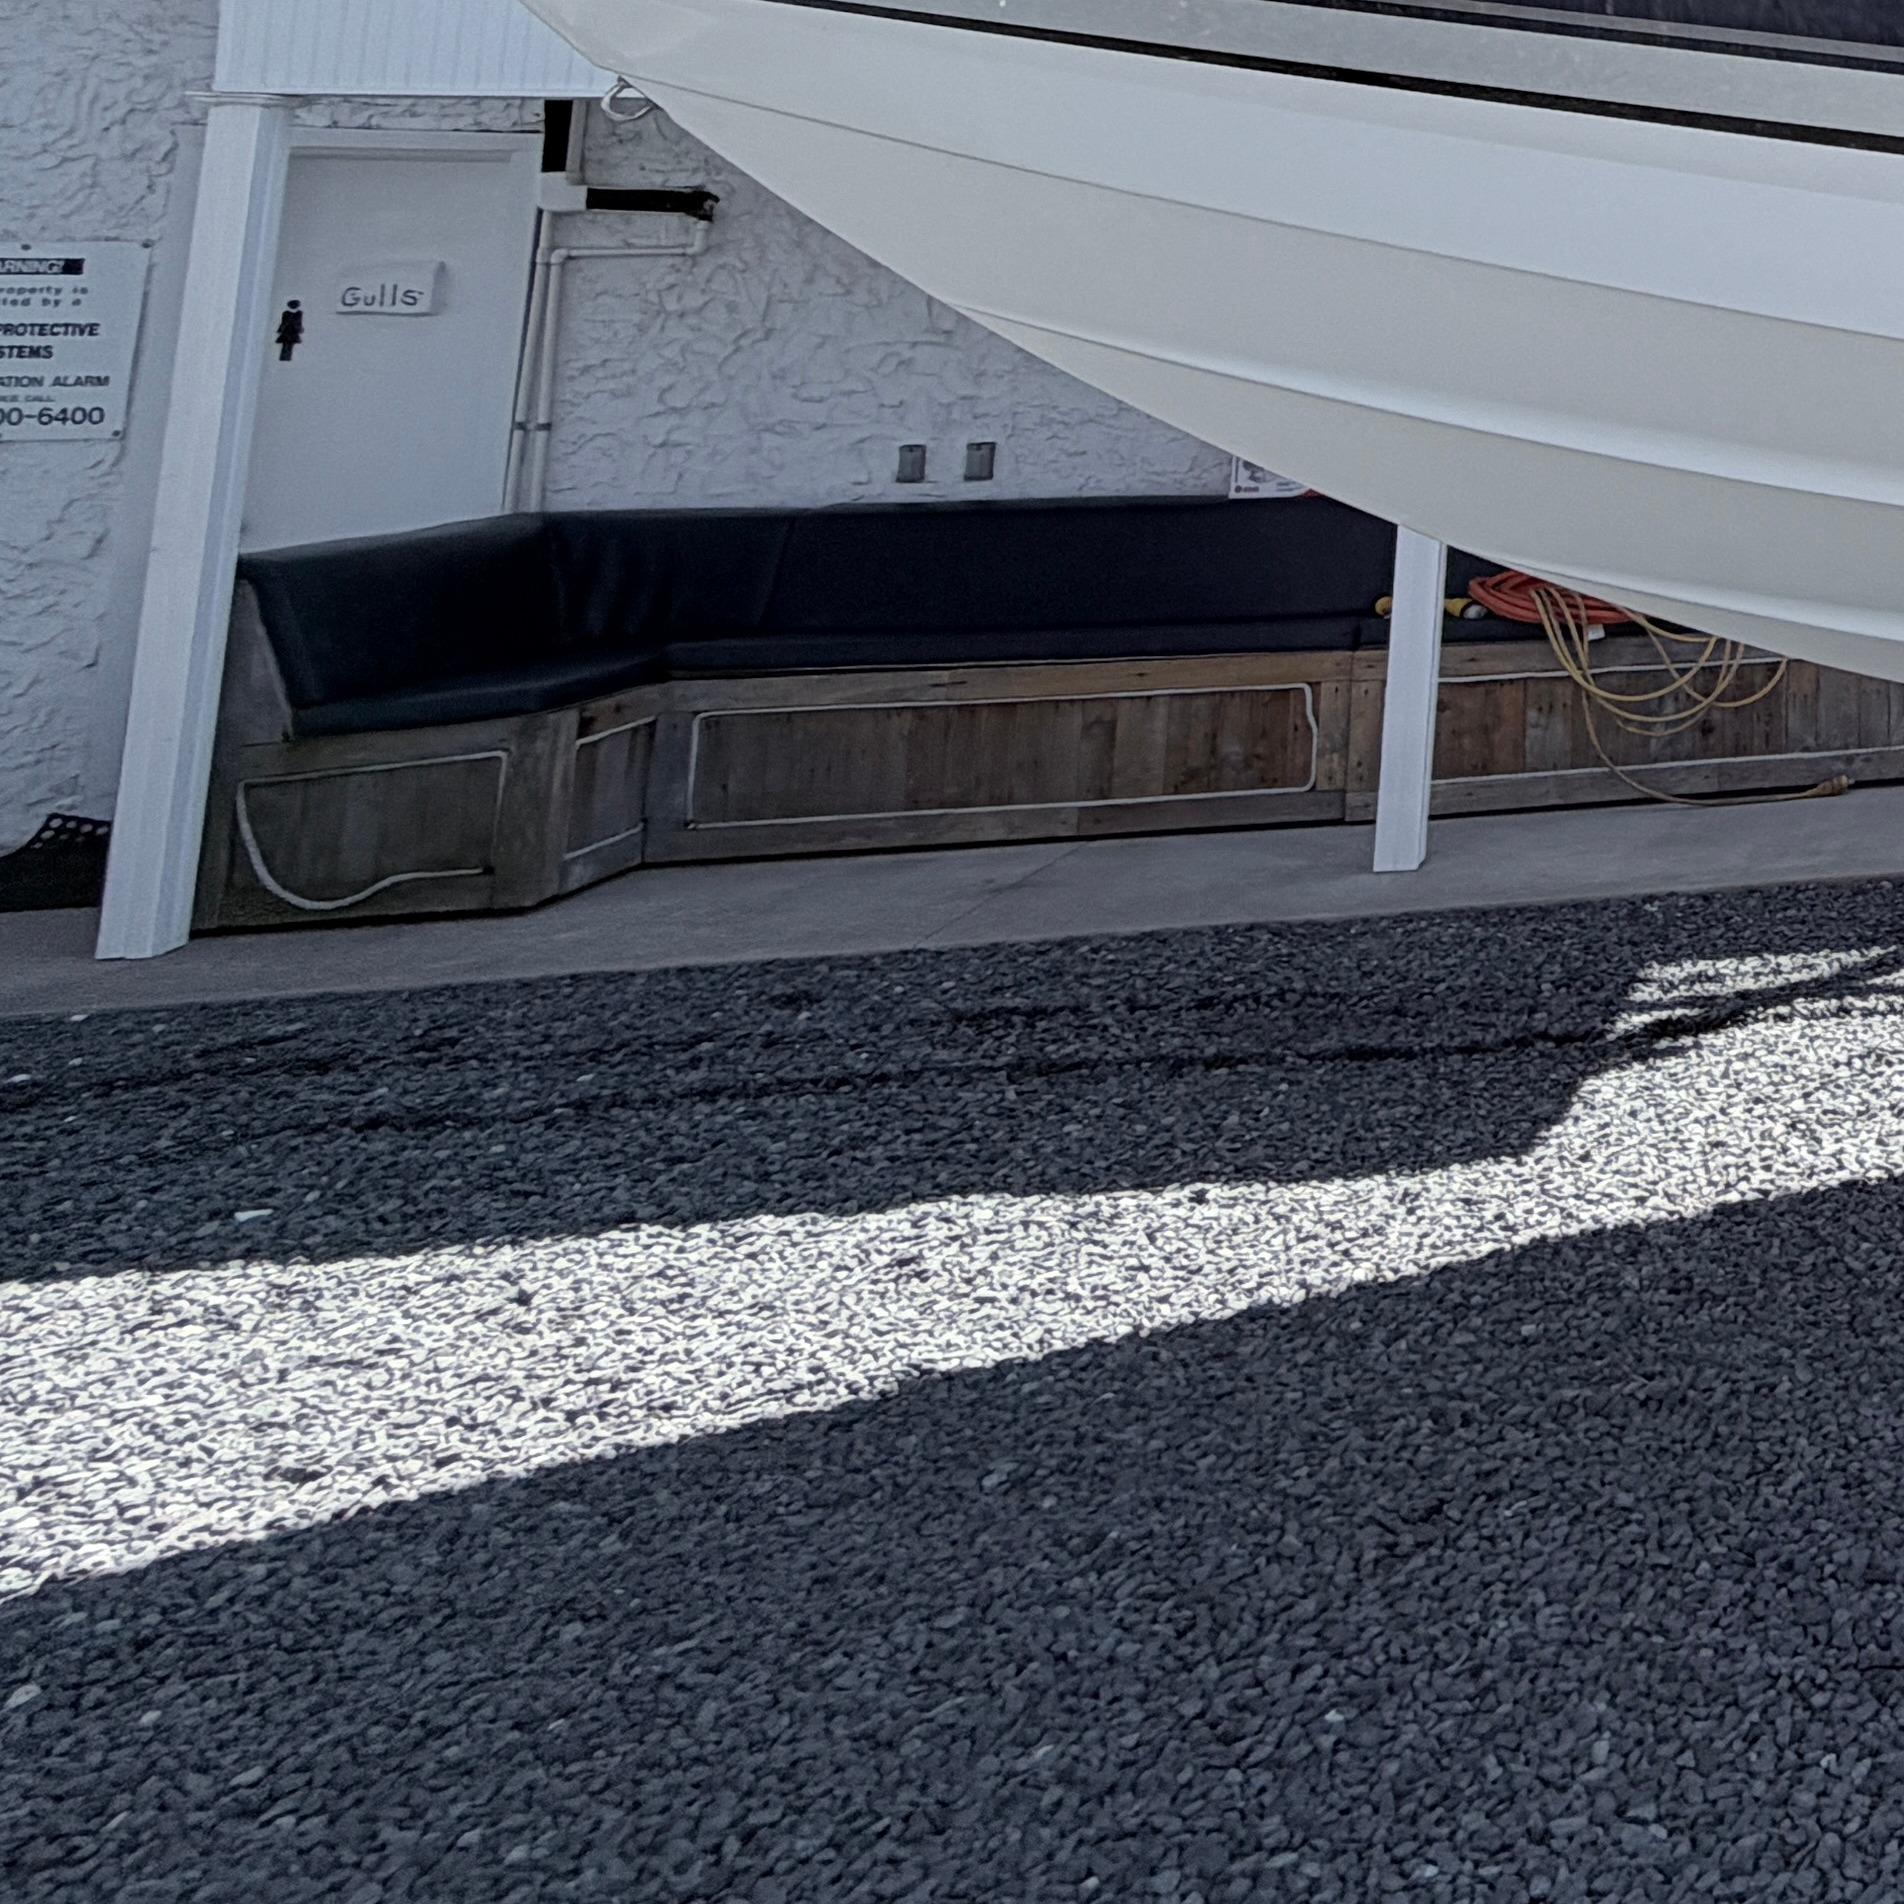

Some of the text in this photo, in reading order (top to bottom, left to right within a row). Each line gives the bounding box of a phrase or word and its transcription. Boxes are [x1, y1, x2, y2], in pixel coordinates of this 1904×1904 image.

[341, 284, 424, 308] Gulls
[0, 322, 100, 337] ROTECTIVE
[51, 375, 110, 387] ALARM
